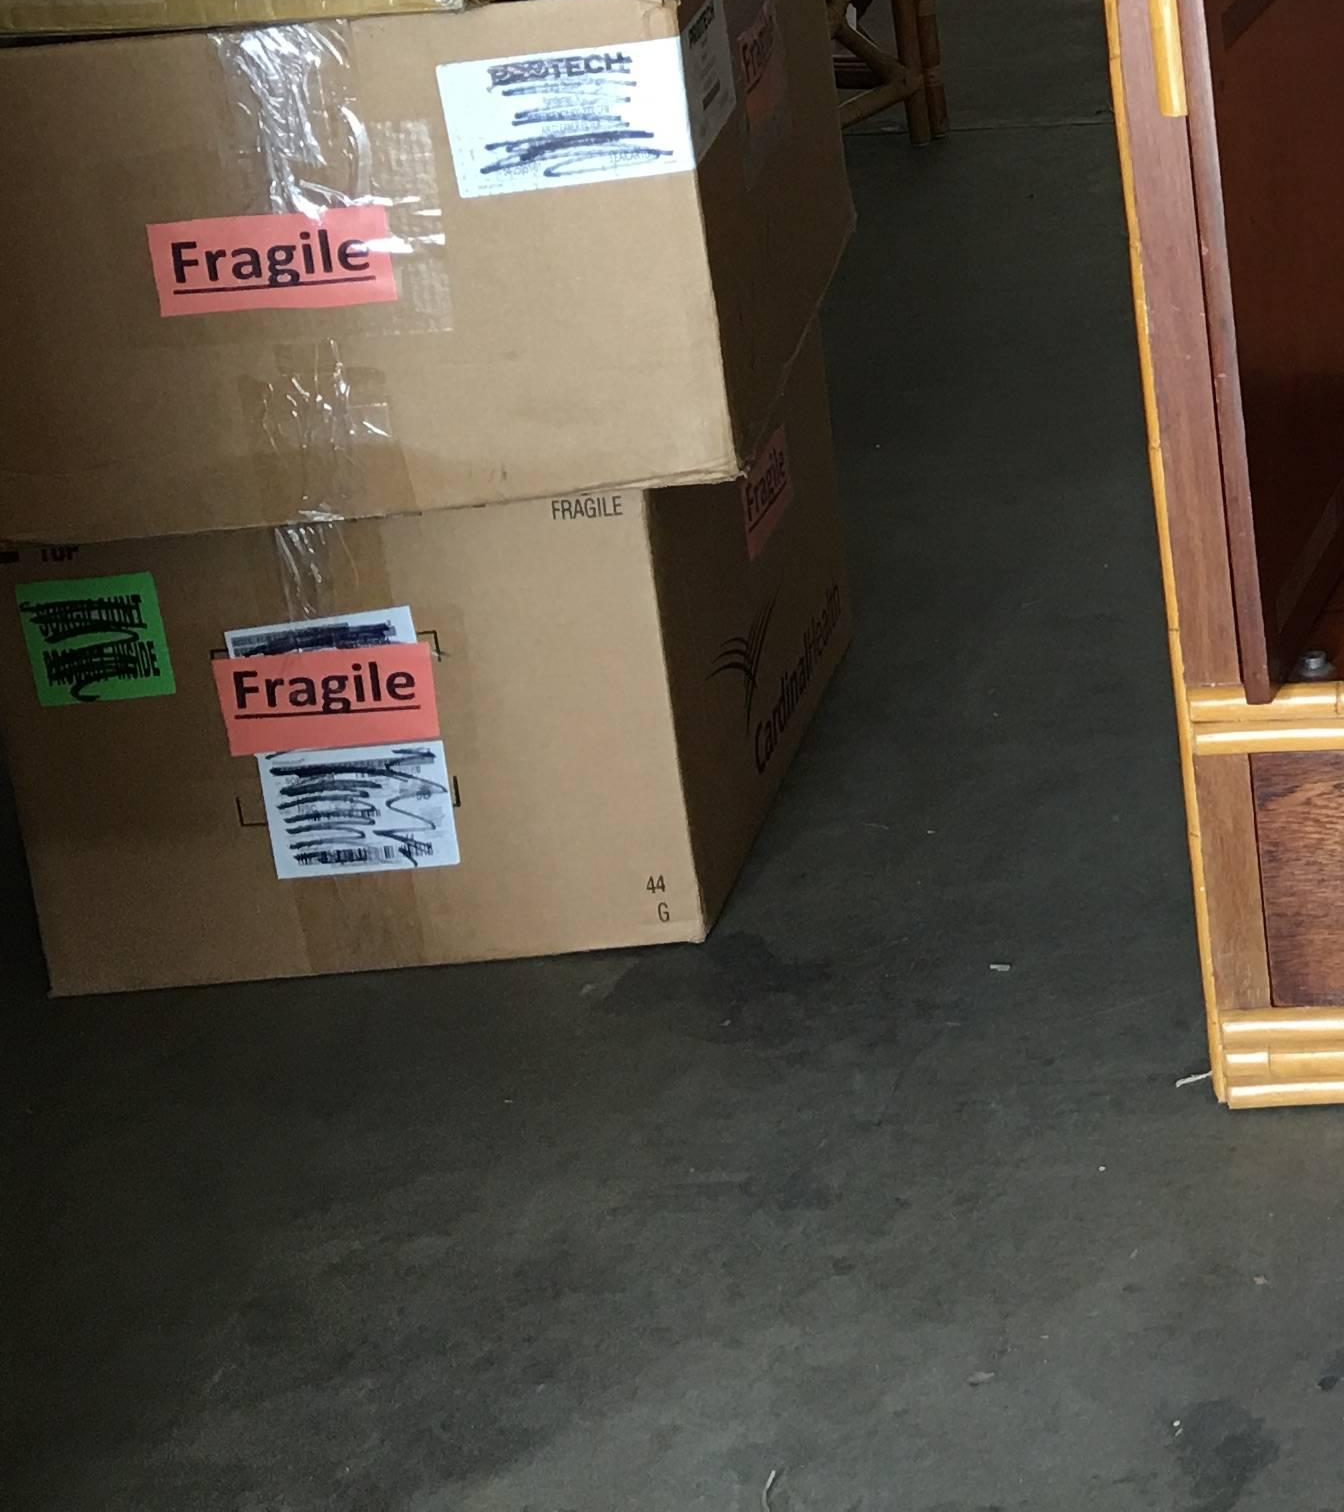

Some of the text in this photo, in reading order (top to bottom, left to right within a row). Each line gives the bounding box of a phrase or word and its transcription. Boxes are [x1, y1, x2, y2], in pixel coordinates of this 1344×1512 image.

[171, 228, 371, 287] Fragile
[746, 447, 787, 523] Fragile
[551, 495, 624, 520] FRAGILE
[232, 661, 415, 714] Fragile
[646, 874, 666, 894] 44
[657, 901, 670, 922] G
